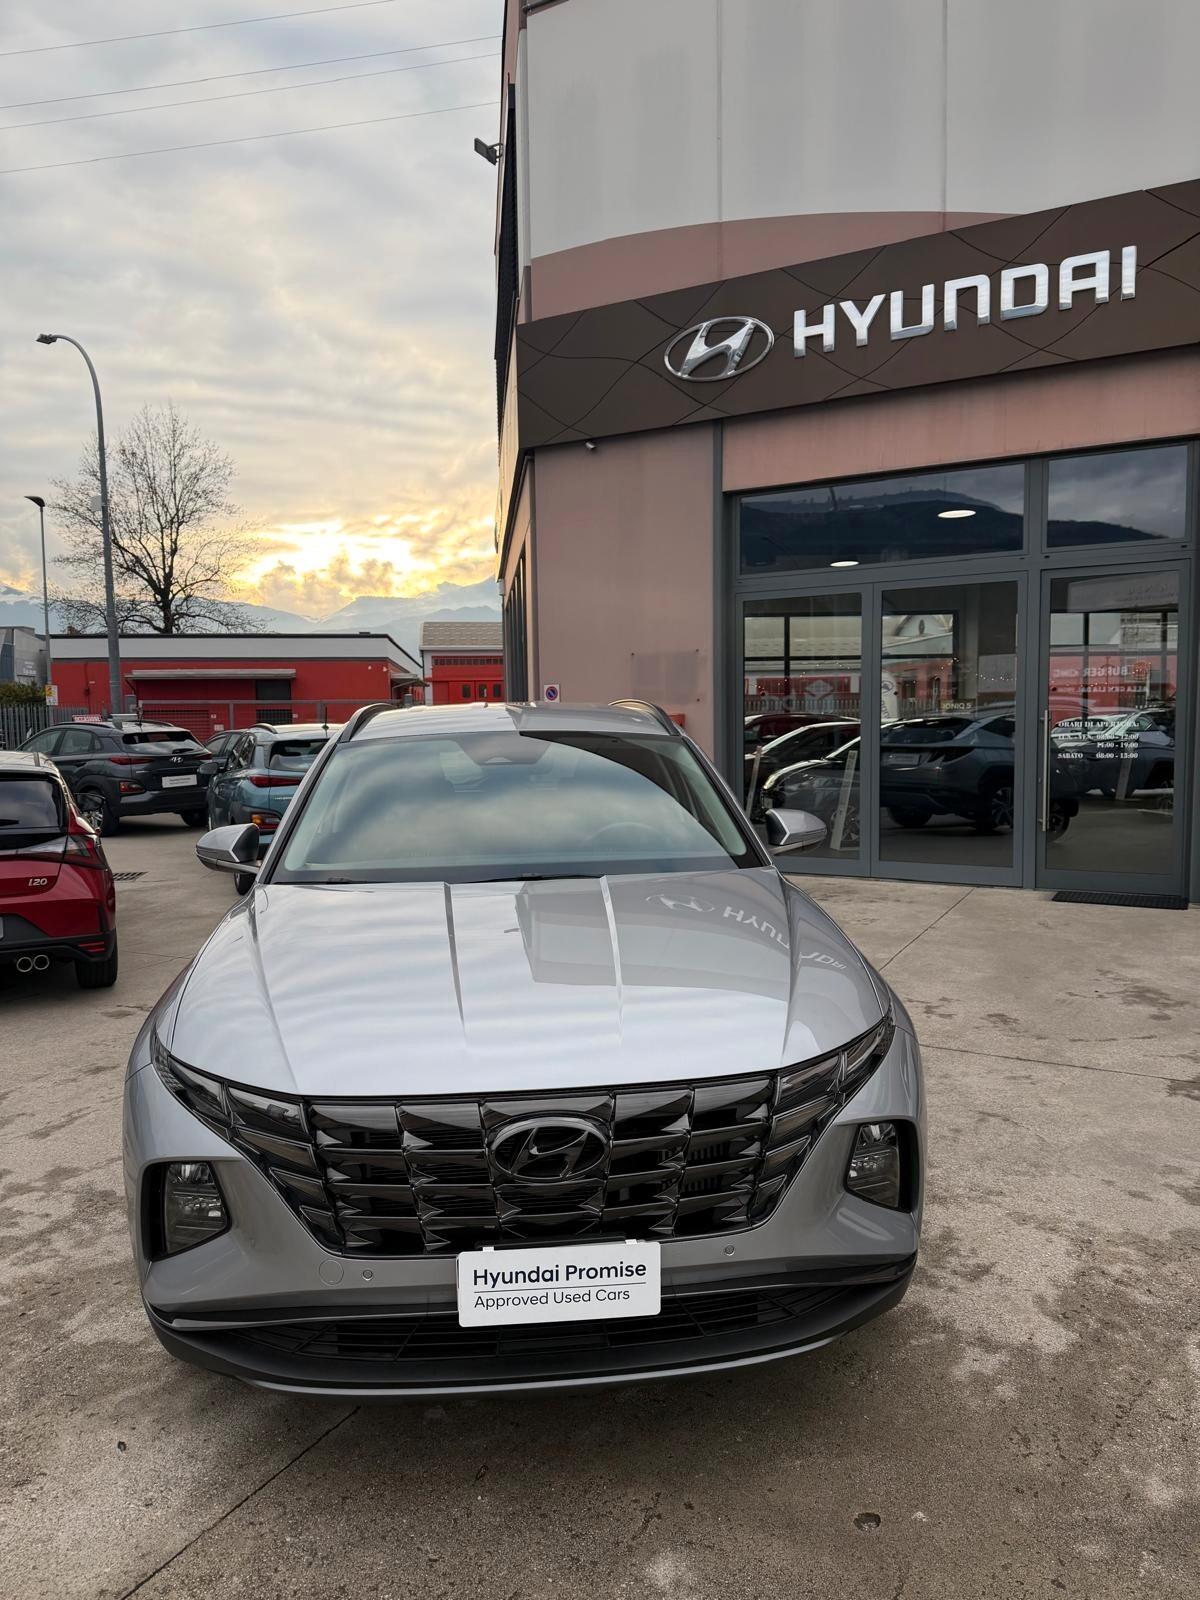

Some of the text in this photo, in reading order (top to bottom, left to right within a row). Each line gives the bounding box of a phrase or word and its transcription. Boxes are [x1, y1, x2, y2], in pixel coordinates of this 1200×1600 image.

[793, 244, 1138, 358] HYUNDAI
[473, 1261, 647, 1288] Hyundai Promise
[474, 1289, 630, 1310] Approved Used Cars
